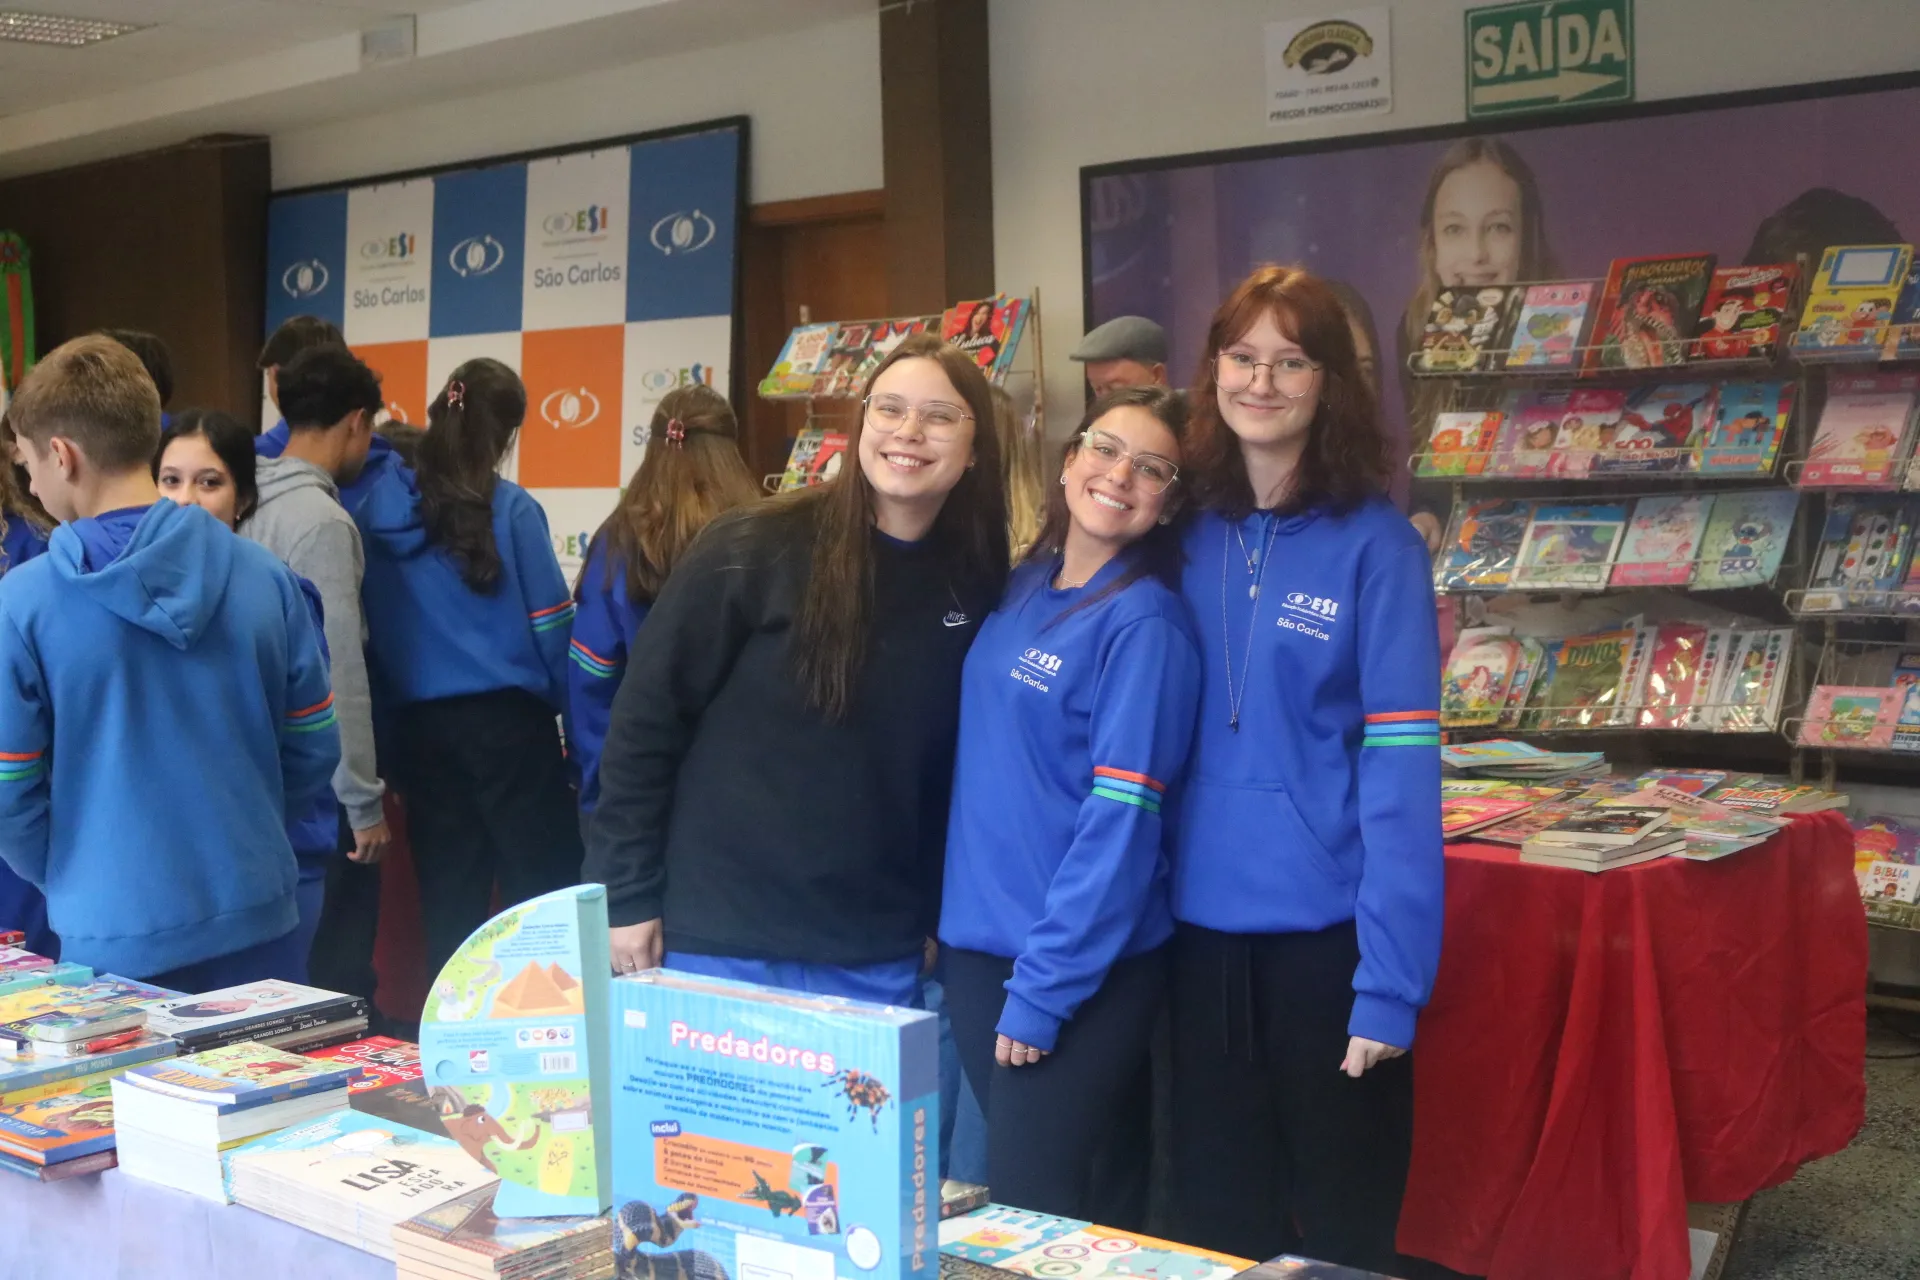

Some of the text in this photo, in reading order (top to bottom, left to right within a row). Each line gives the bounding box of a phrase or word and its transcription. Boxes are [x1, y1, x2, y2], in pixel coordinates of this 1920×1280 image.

[1473, 4, 1626, 79] SAÍDA
[576, 204, 608, 235] ESI
[388, 232, 415, 258] ESI
[534, 261, 622, 289] São Carlos
[353, 284, 426, 309] São Carlos
[946, 610, 966, 623] NIKE
[1311, 597, 1339, 616] ESI
[1277, 617, 1330, 641] São Carlos
[1039, 652, 1063, 672] ESI
[1567, 641, 1621, 667] DINOS
[1010, 668, 1049, 693] São Carlos
[244, 1021, 266, 1031] GRANDES
[266, 1018, 285, 1027] SONHOS
[253, 1030, 274, 1039] GRANDES
[274, 1026, 293, 1036] SONHOS
[670, 1020, 836, 1074] Predadores
[686, 1072, 756, 1094] PREDADORES
[340, 1159, 420, 1192] LISA
[398, 1168, 442, 1187] ESCA
[441, 1180, 467, 1192] RA
[401, 1179, 445, 1198] LADO
[911, 1106, 926, 1273] Predadores
